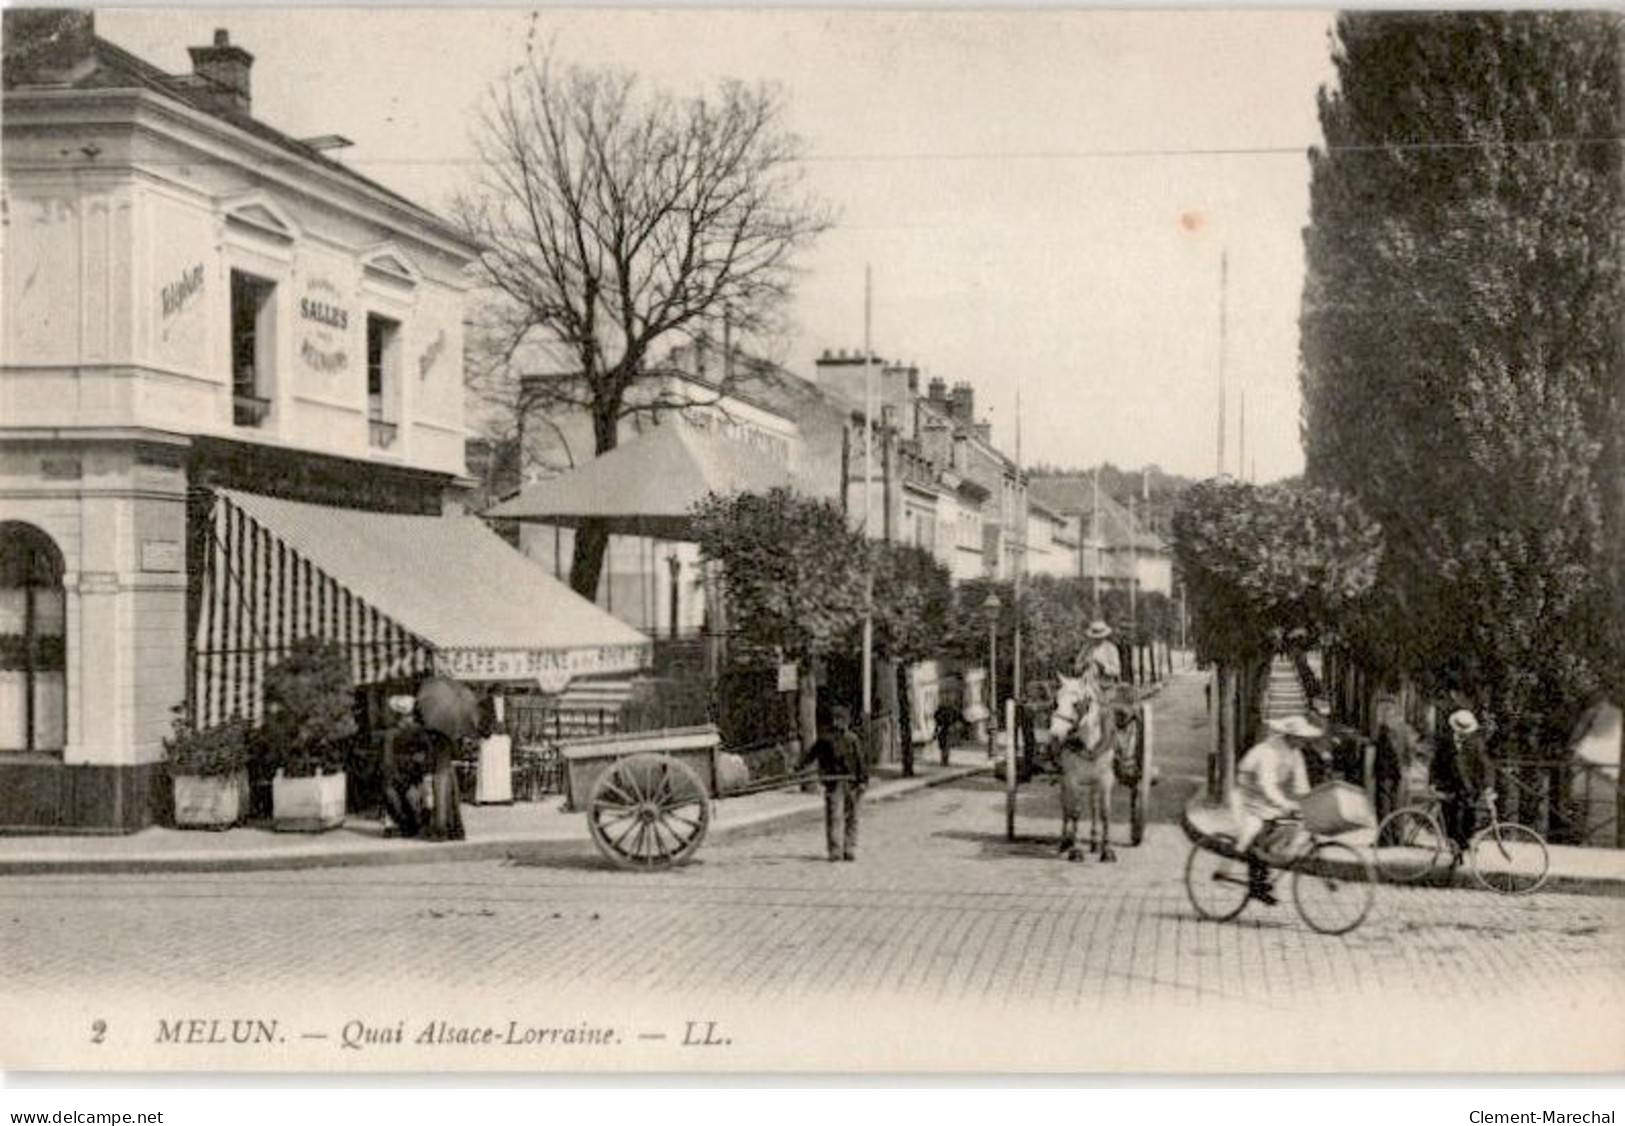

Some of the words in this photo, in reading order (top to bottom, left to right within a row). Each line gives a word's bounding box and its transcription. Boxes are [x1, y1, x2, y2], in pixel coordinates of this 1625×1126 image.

[300, 297, 348, 330] SALLES
[90, 1021, 108, 1044] 2
[154, 1020, 285, 1045] MELUN.
[341, 1021, 405, 1051] Quai
[414, 1021, 622, 1045] Alsace-Lorraine.
[681, 1021, 734, 1046] LL.
